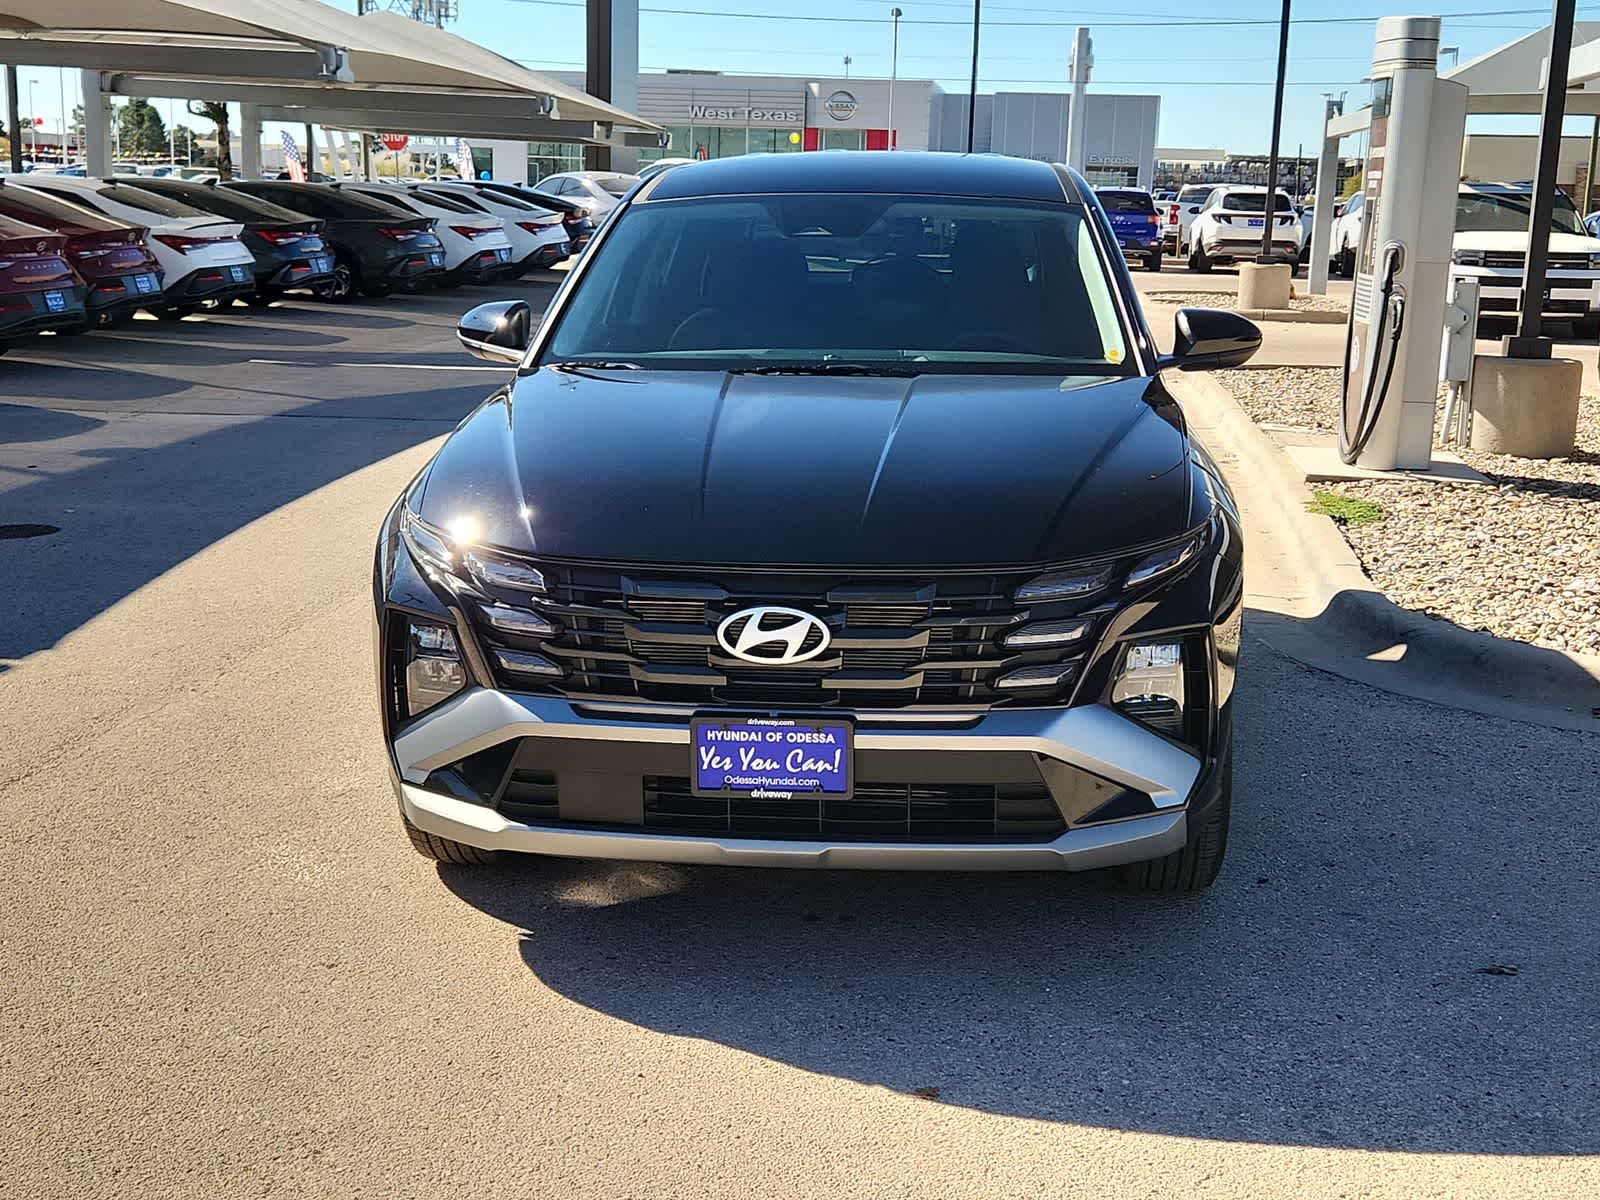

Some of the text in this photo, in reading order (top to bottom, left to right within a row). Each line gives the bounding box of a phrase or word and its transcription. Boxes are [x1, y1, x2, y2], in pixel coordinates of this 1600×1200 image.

[826, 101, 859, 109] NISSAN
[688, 105, 798, 121] West Texas
[747, 718, 795, 727] driveway.com
[707, 730, 836, 744] HYUNDAI OF ODESSA
[699, 745, 842, 774] Yes You Can!
[724, 775, 820, 787] OdessaHyundai.com
[750, 788, 793, 800] driveway
